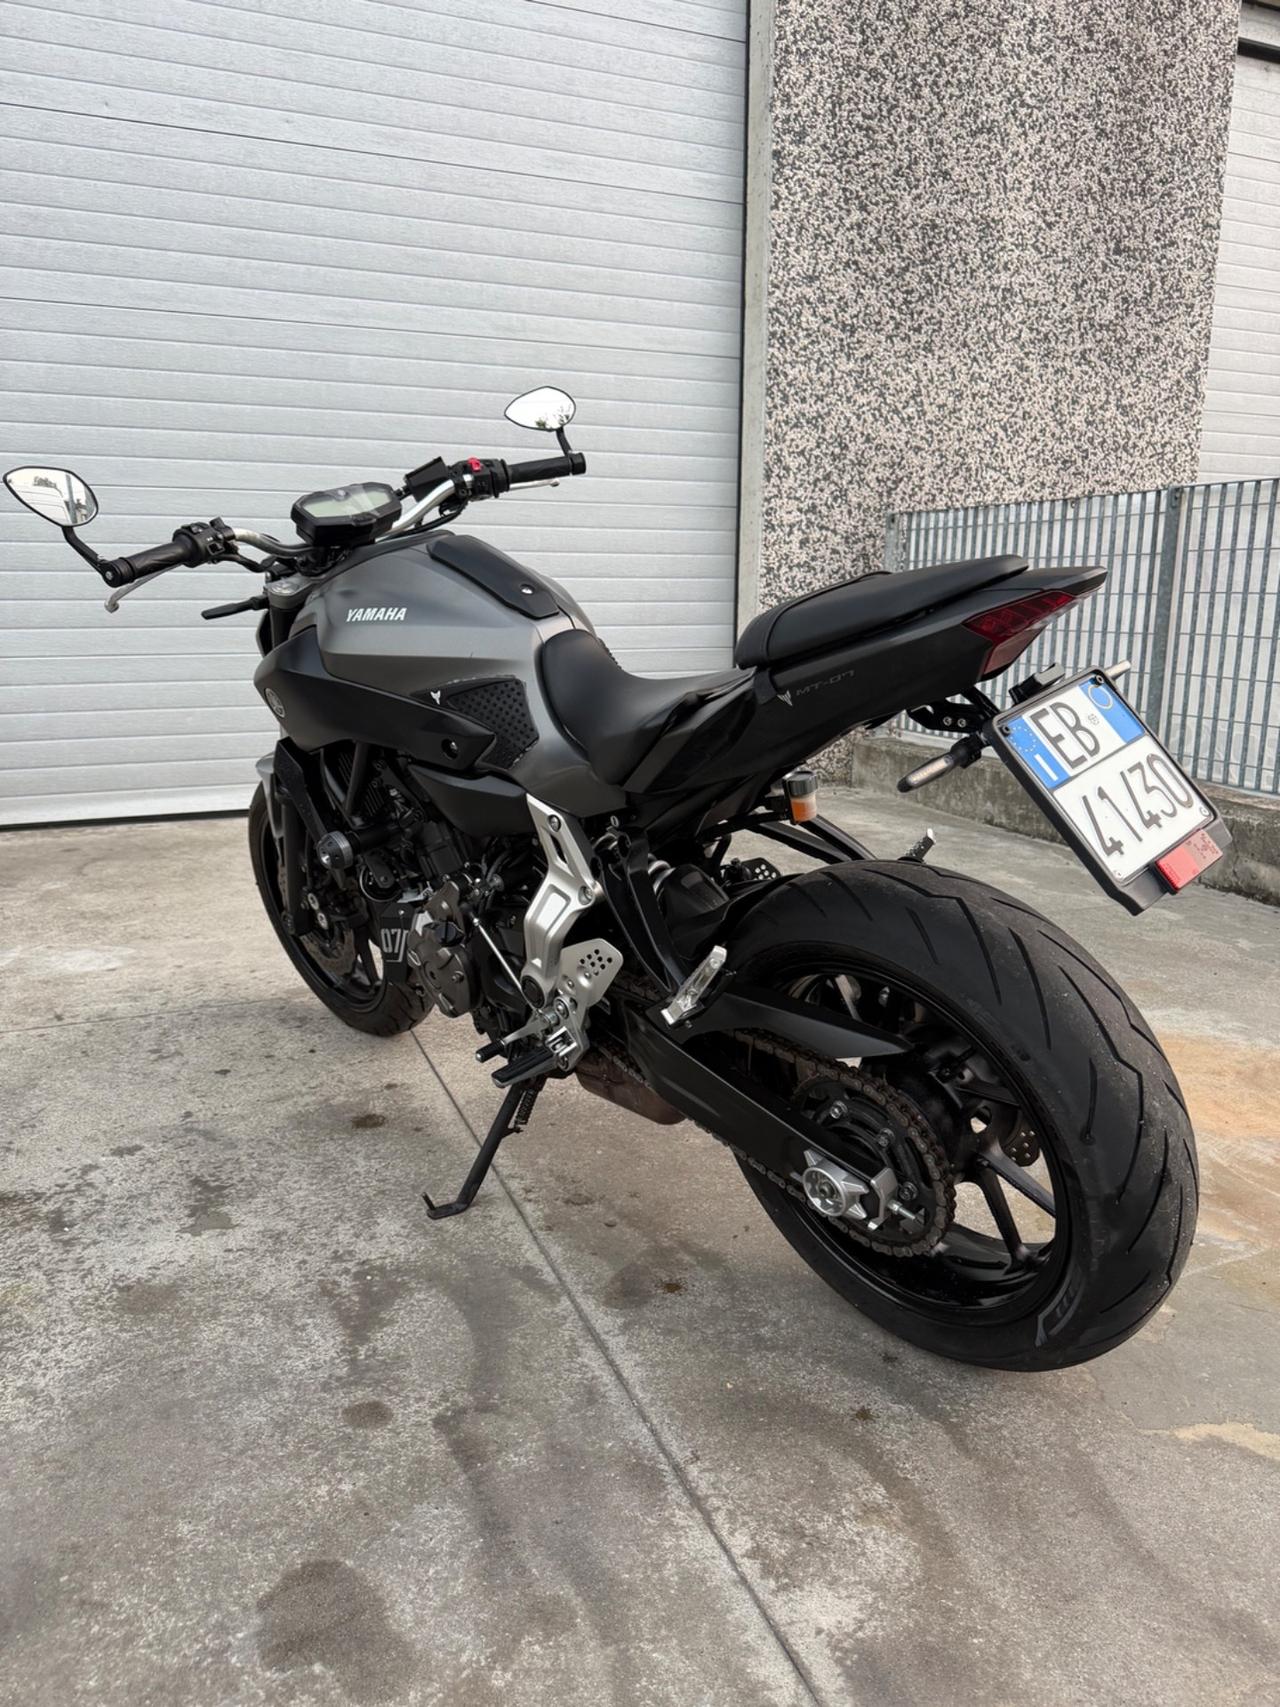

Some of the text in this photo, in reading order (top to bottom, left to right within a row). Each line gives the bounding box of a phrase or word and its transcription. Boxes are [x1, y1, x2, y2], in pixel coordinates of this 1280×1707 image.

[346, 607, 407, 622] YAMAHA
[796, 669, 855, 696] MT-07
[1029, 701, 1100, 769] EB
[1082, 753, 1194, 857] 41430
